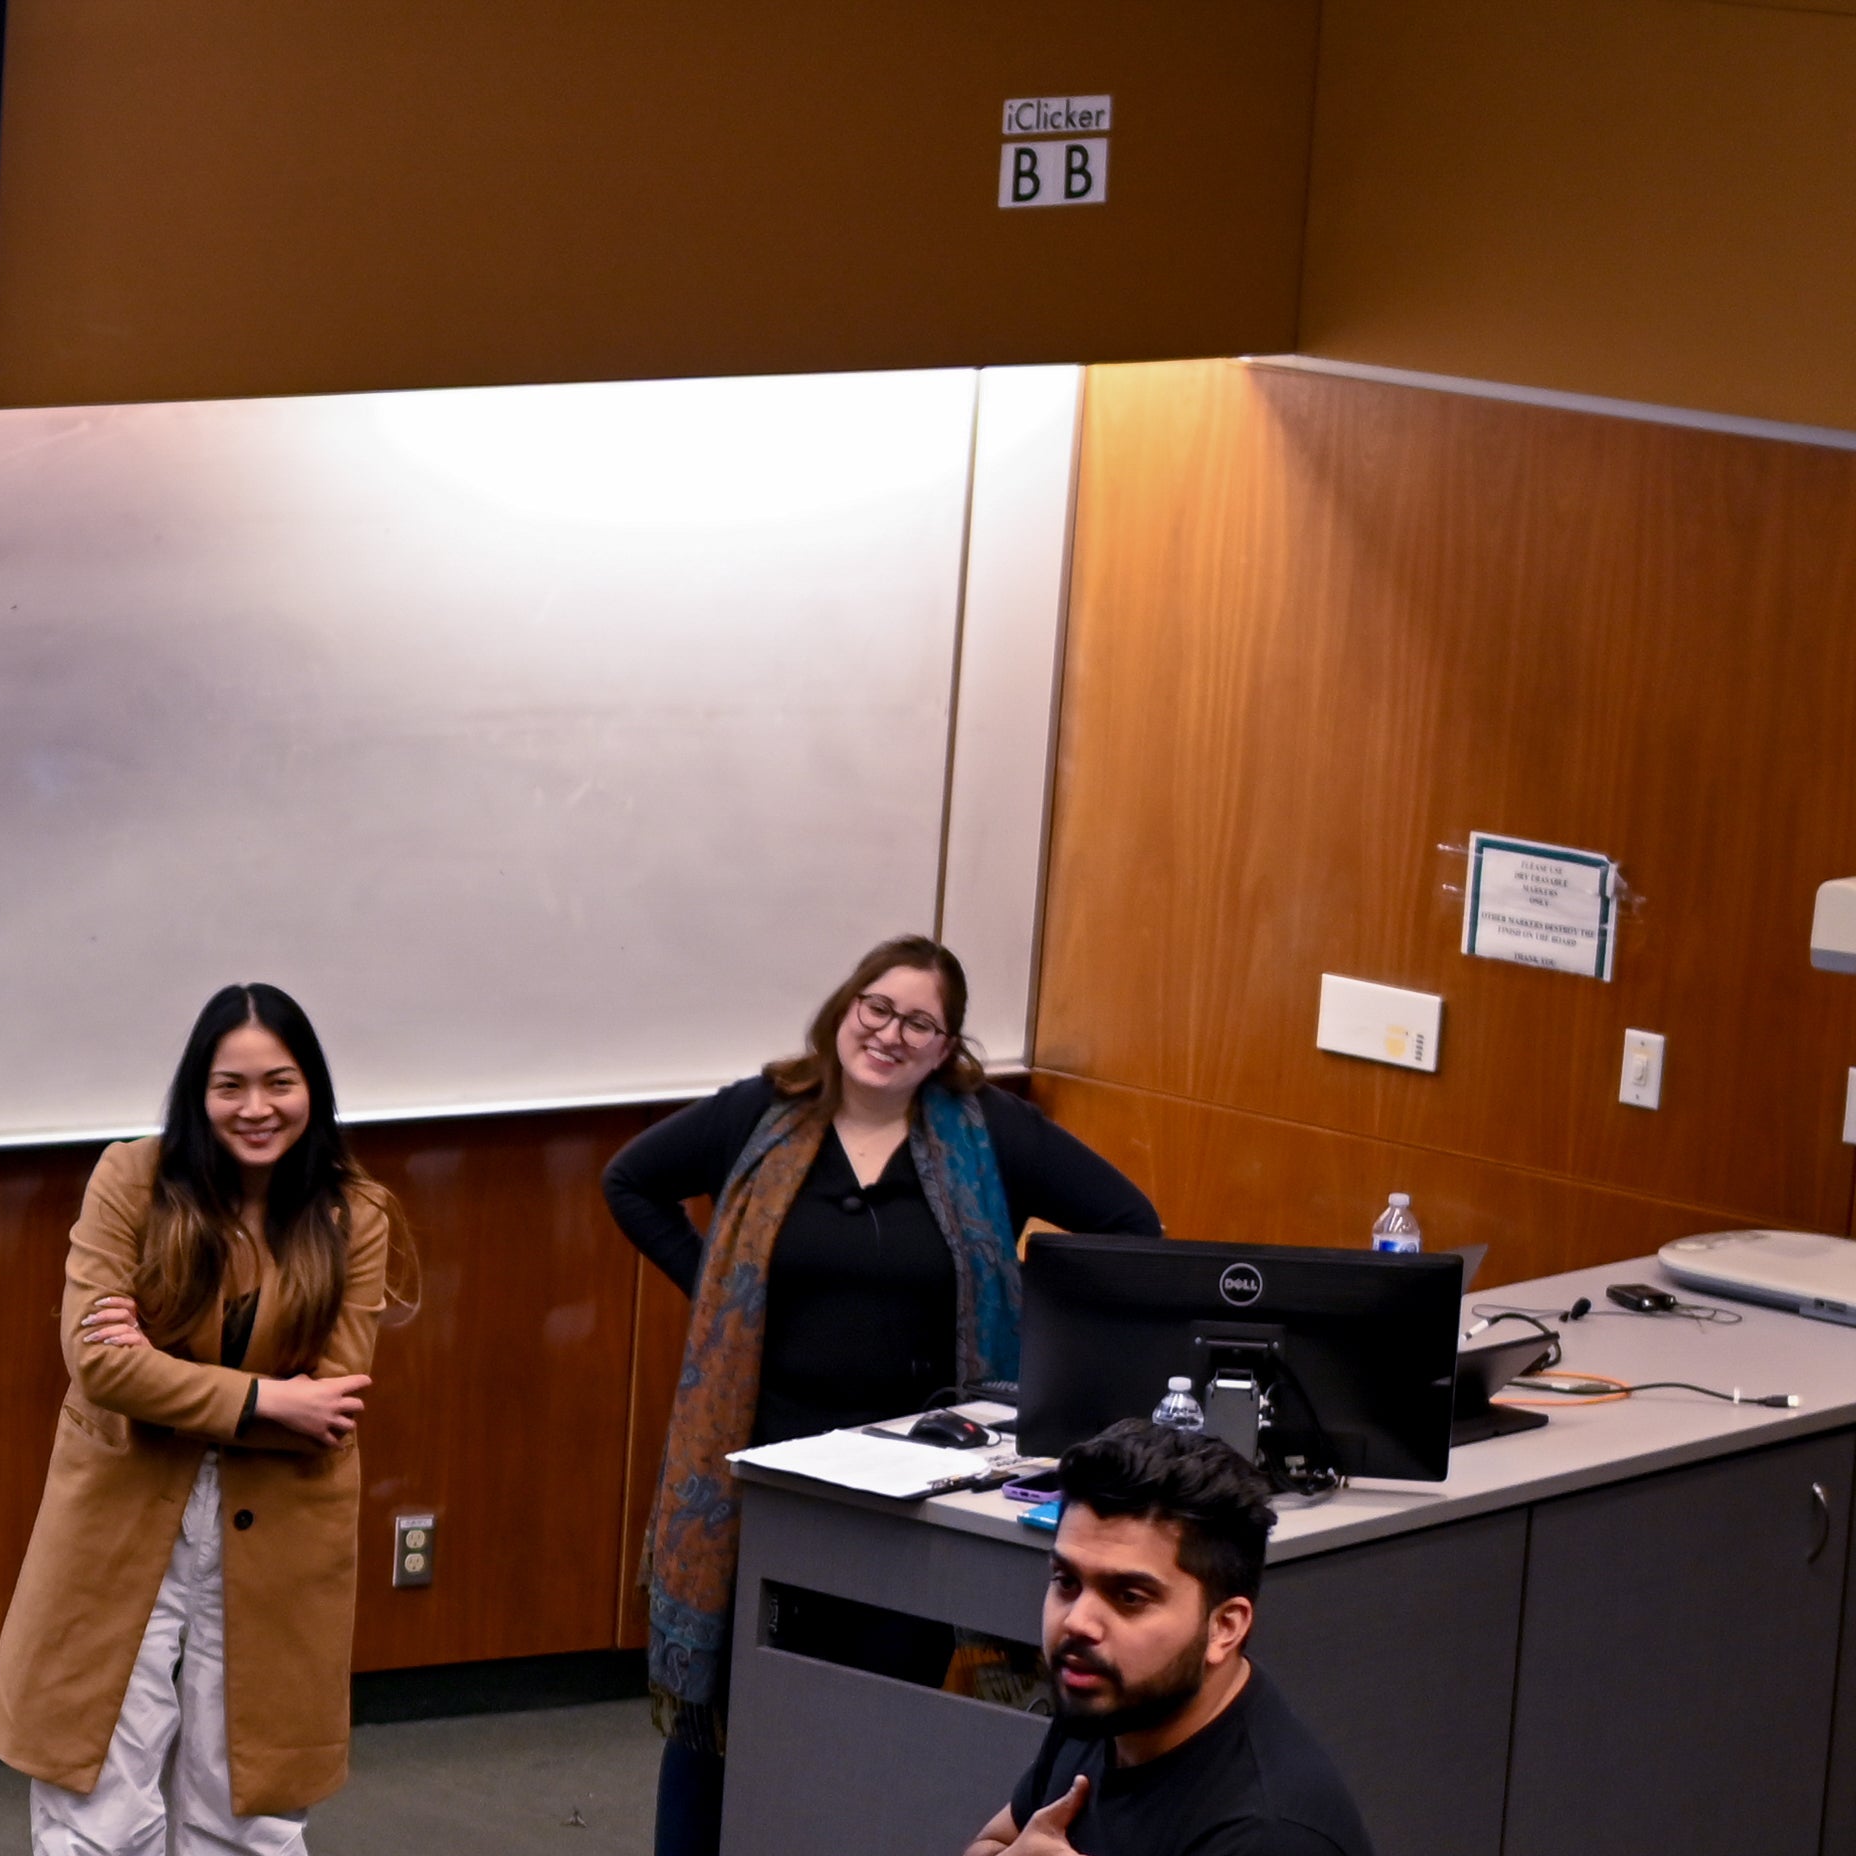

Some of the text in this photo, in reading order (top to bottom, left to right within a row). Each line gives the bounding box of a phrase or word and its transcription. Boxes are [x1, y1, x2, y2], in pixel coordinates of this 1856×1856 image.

[1007, 99, 1106, 131] iClicker
[1012, 144, 1093, 202] B B
[1225, 1278, 1258, 1291] DELL
